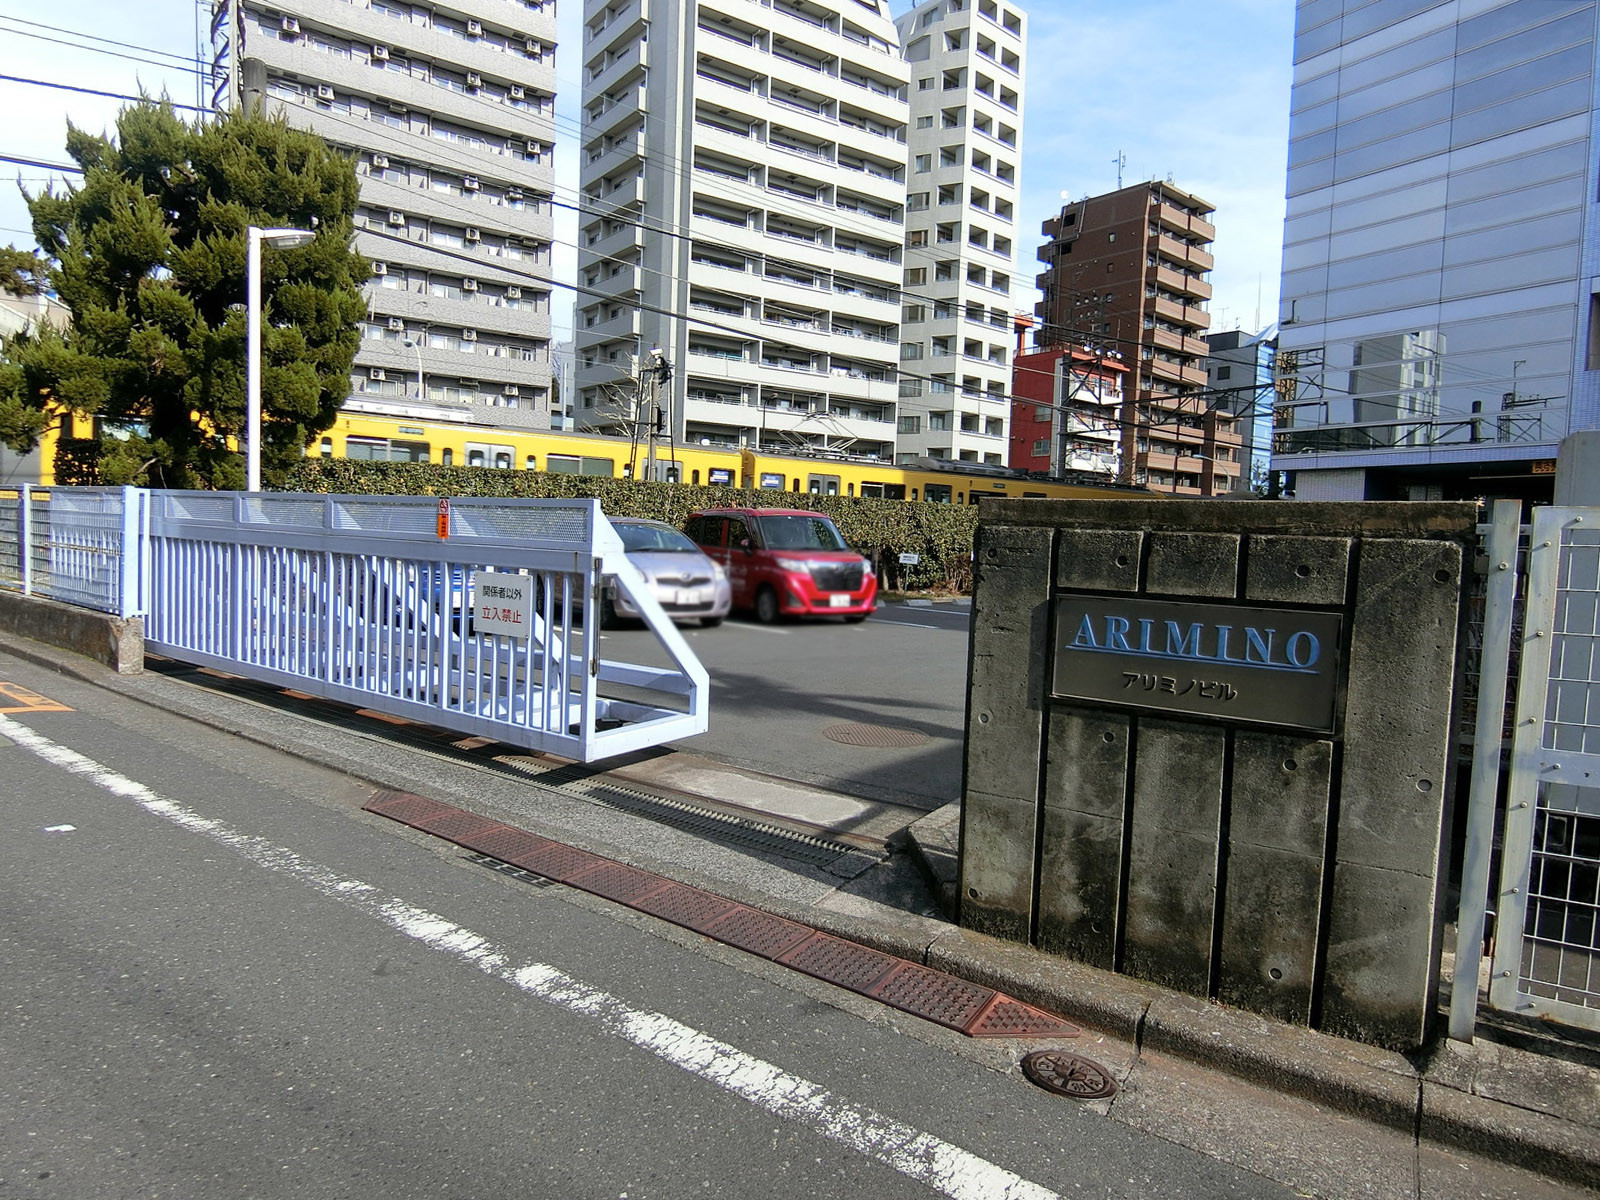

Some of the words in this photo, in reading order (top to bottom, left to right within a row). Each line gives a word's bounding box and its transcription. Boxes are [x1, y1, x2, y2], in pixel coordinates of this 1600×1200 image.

[482, 585, 523, 601] 関係者以外
[481, 606, 523, 624] 立入禁止
[1071, 613, 1321, 668] ARIMINO
[1122, 671, 1238, 701] アリミノビル
